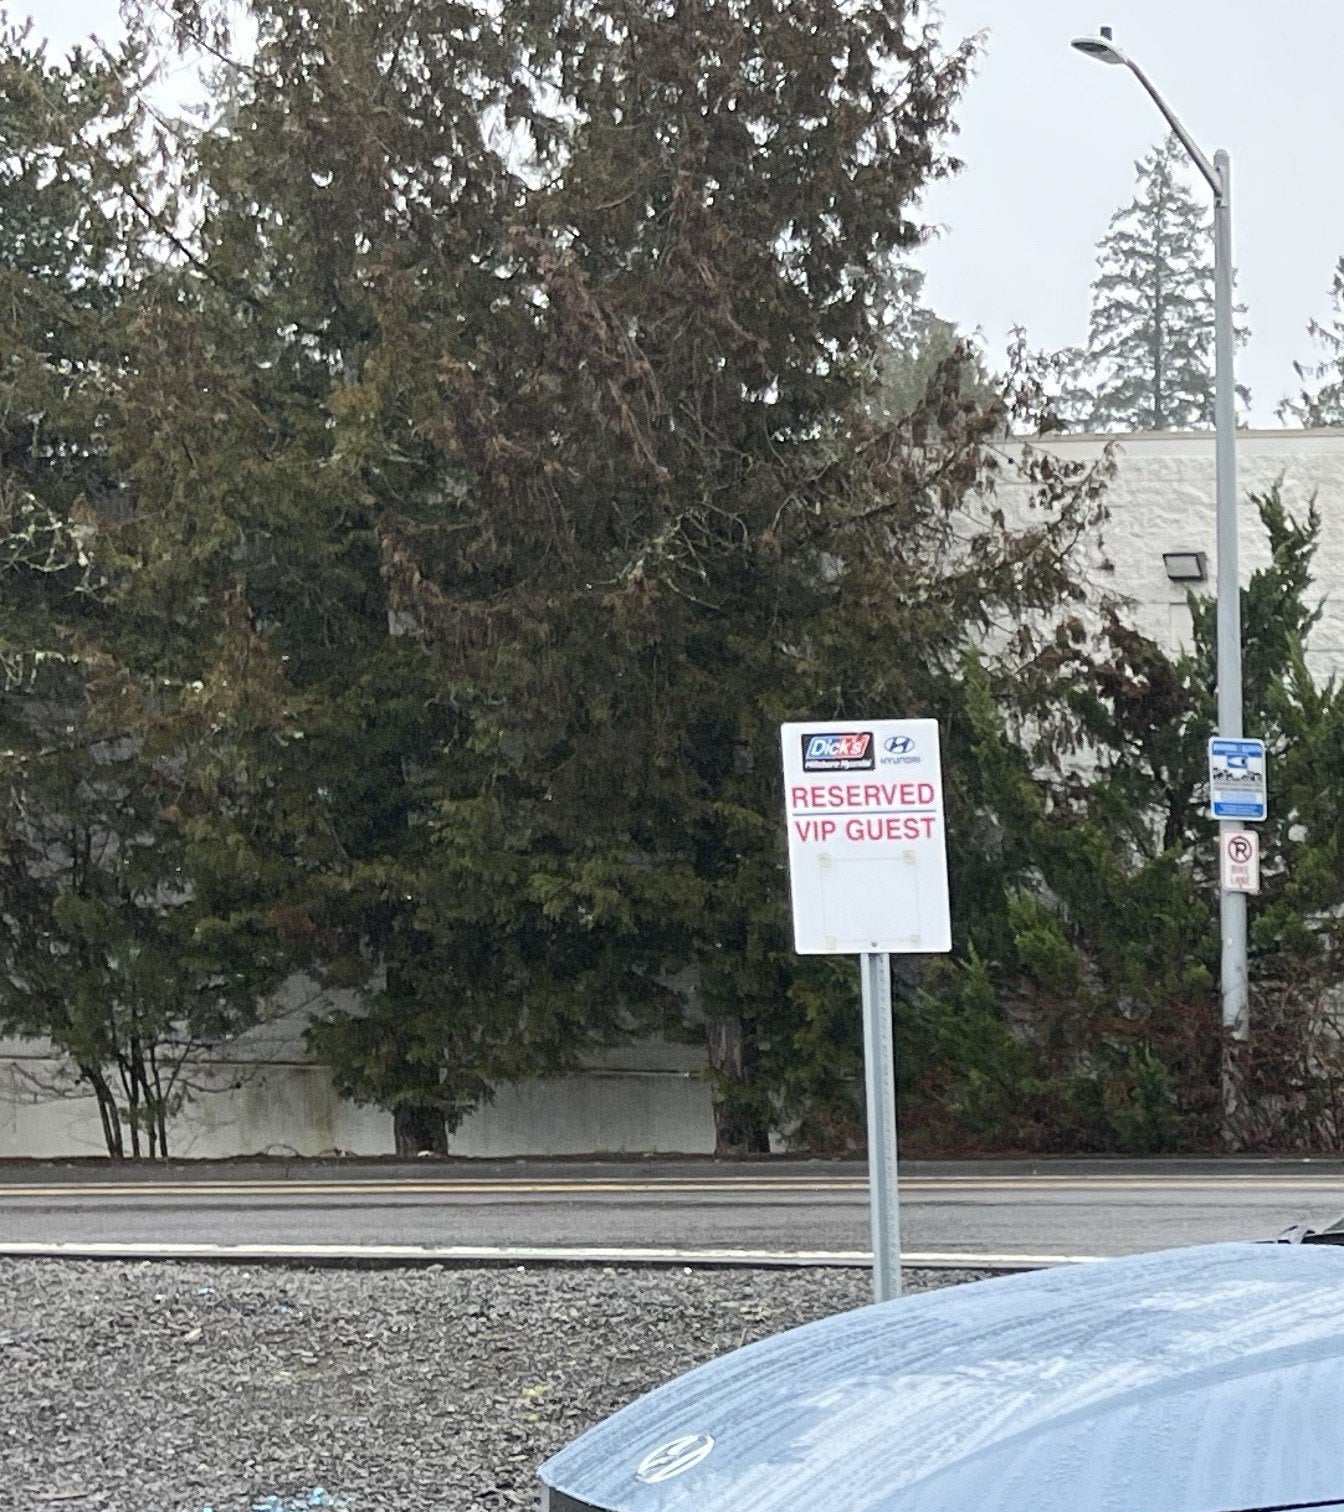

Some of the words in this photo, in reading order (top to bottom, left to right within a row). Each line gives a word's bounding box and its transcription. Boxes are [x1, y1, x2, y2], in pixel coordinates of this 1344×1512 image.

[791, 782, 935, 809] RESERVED
[795, 820, 836, 842] VIP
[846, 817, 936, 841] GUEST
